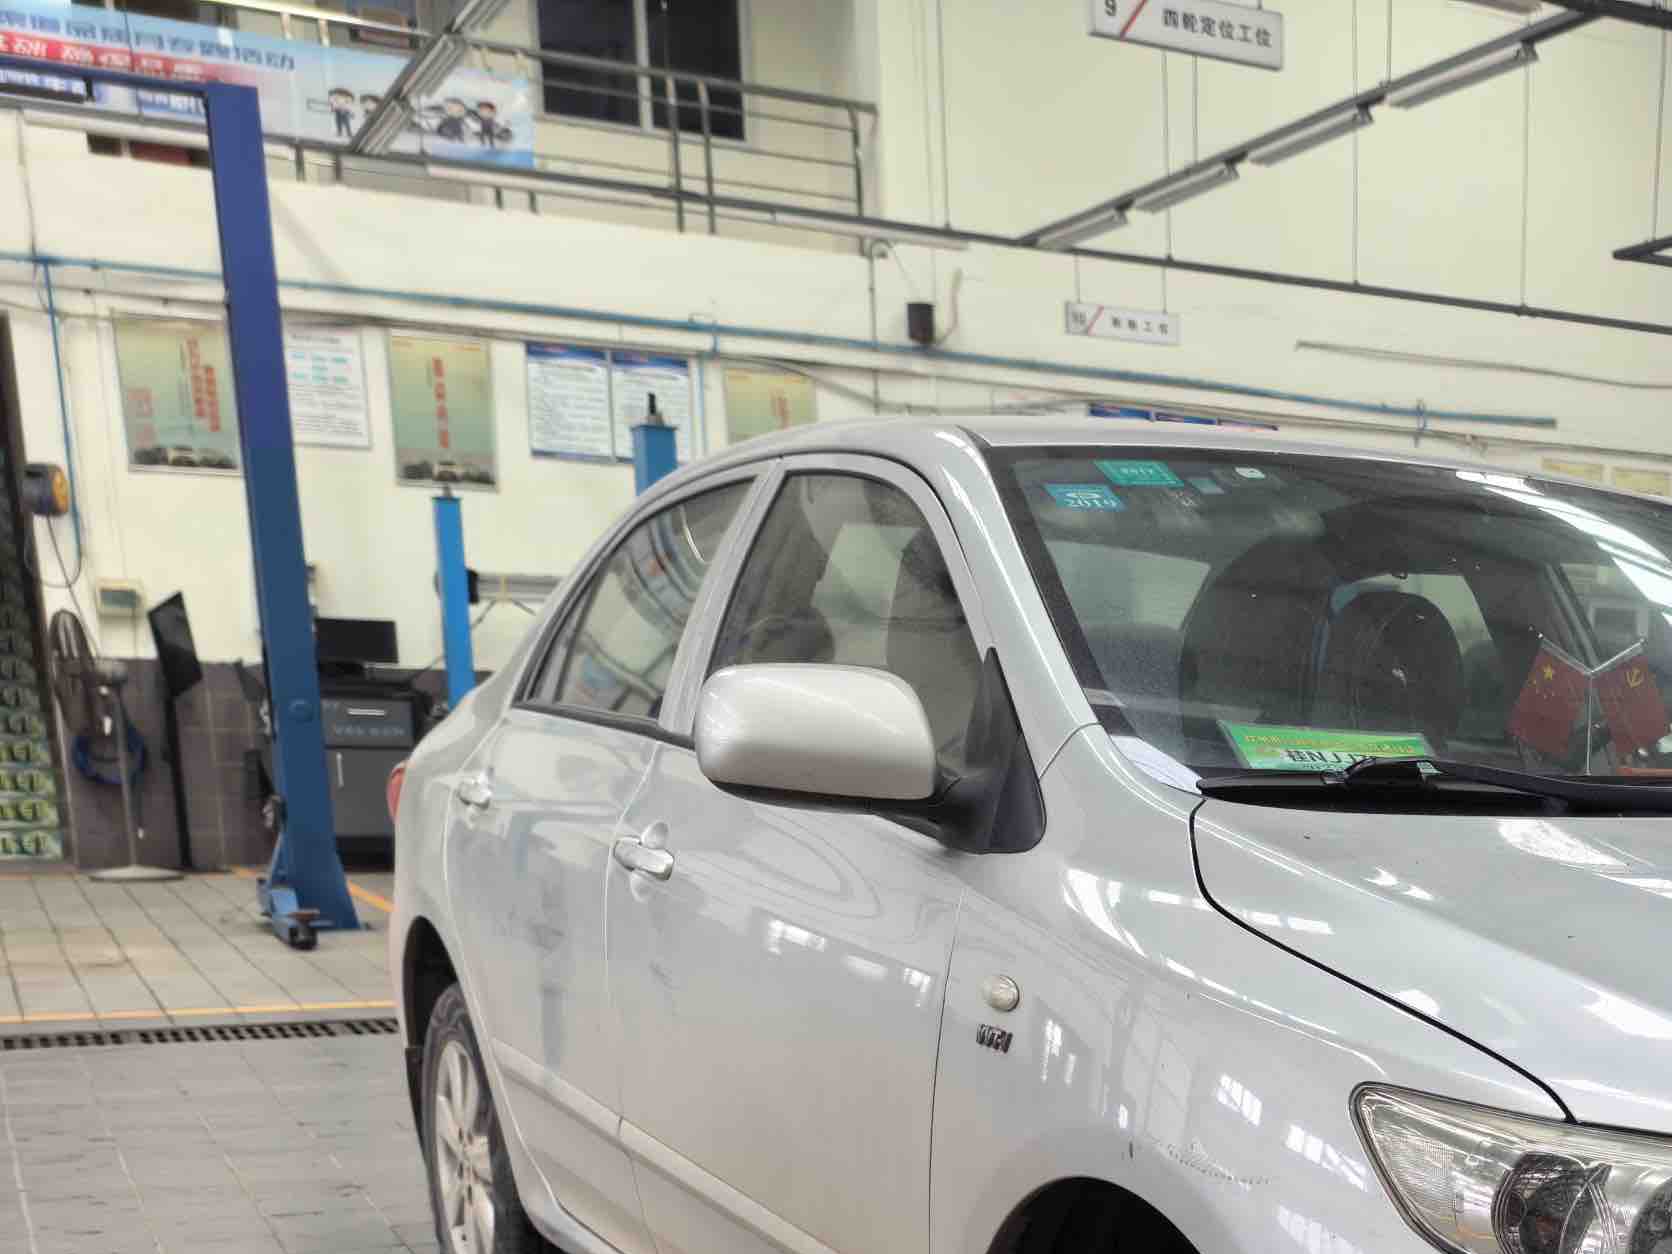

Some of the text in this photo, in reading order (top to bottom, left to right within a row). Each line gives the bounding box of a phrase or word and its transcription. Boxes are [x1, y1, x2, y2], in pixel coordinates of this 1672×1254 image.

[1104, 0, 1273, 48] 9 四轮定位工位
